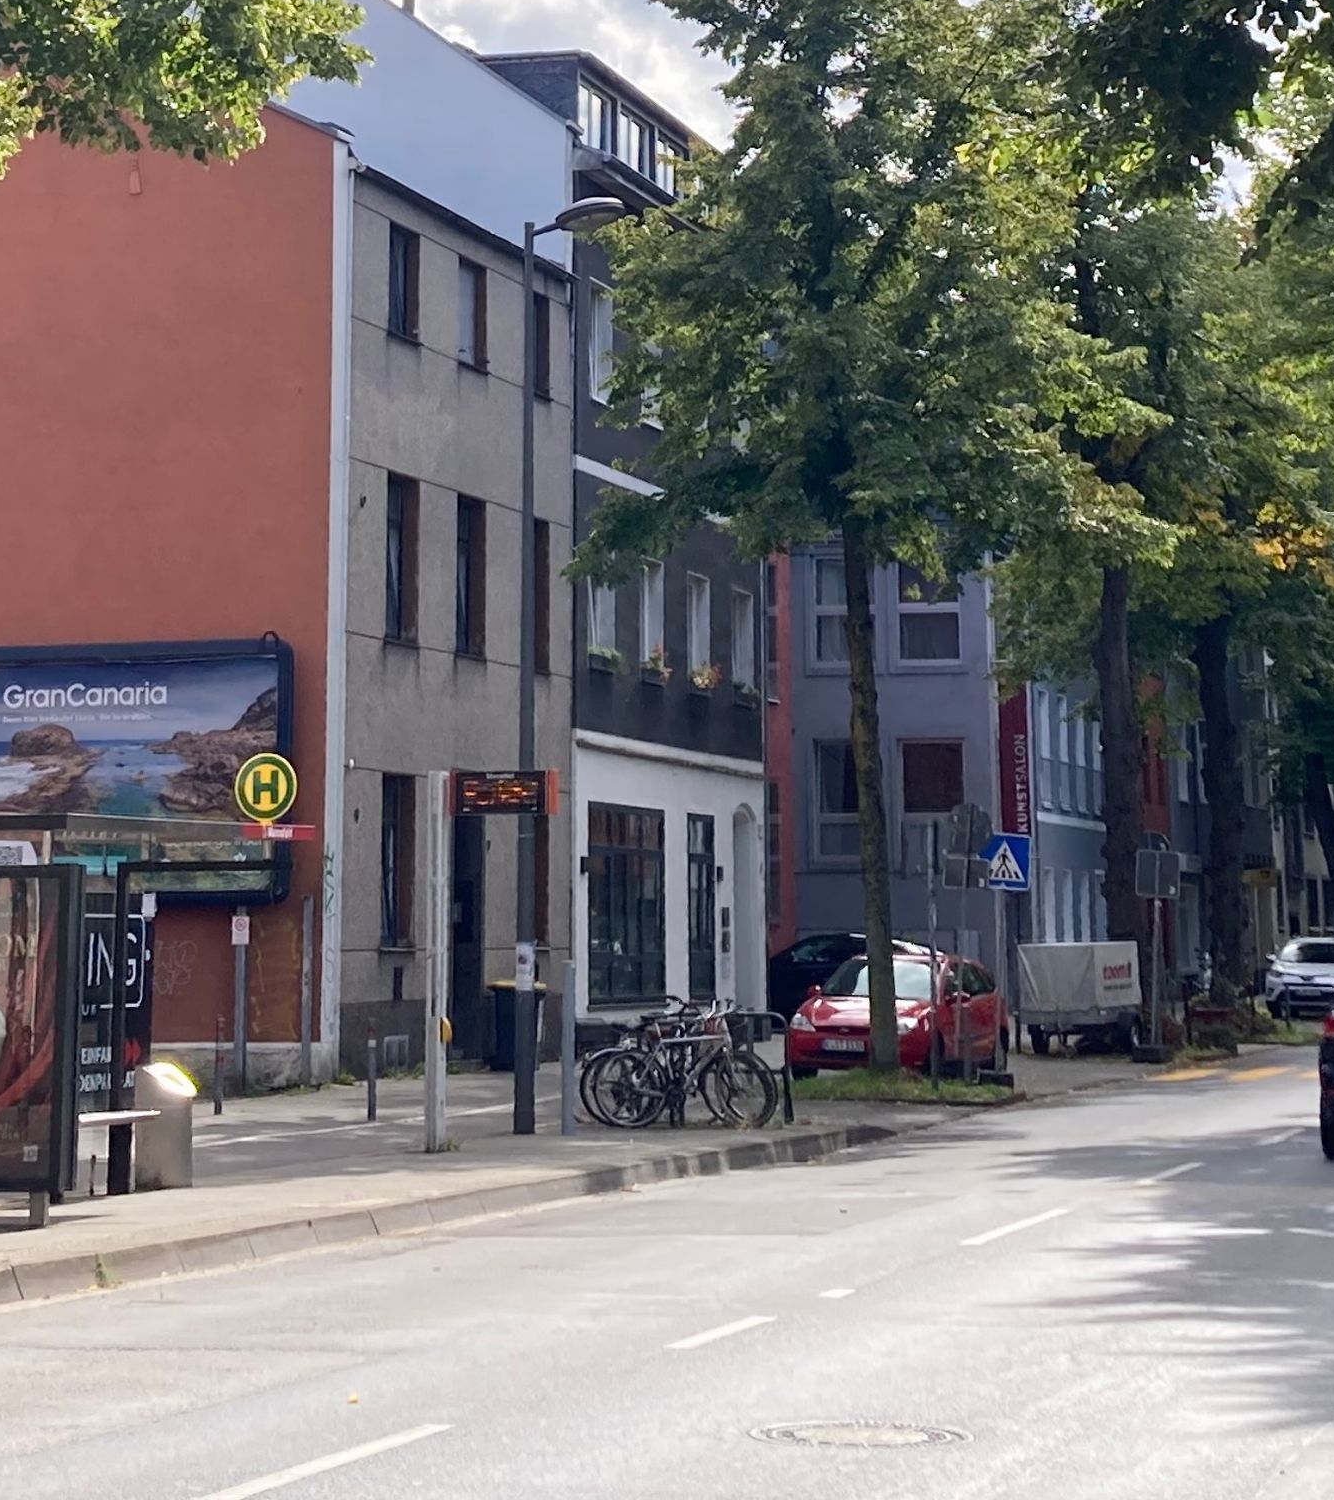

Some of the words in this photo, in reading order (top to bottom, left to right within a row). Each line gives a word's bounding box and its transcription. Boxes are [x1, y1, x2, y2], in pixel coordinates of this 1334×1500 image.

[2, 681, 168, 709] GranCanaria
[252, 770, 279, 805] H
[1013, 733, 1029, 833] KUNSTSALON
